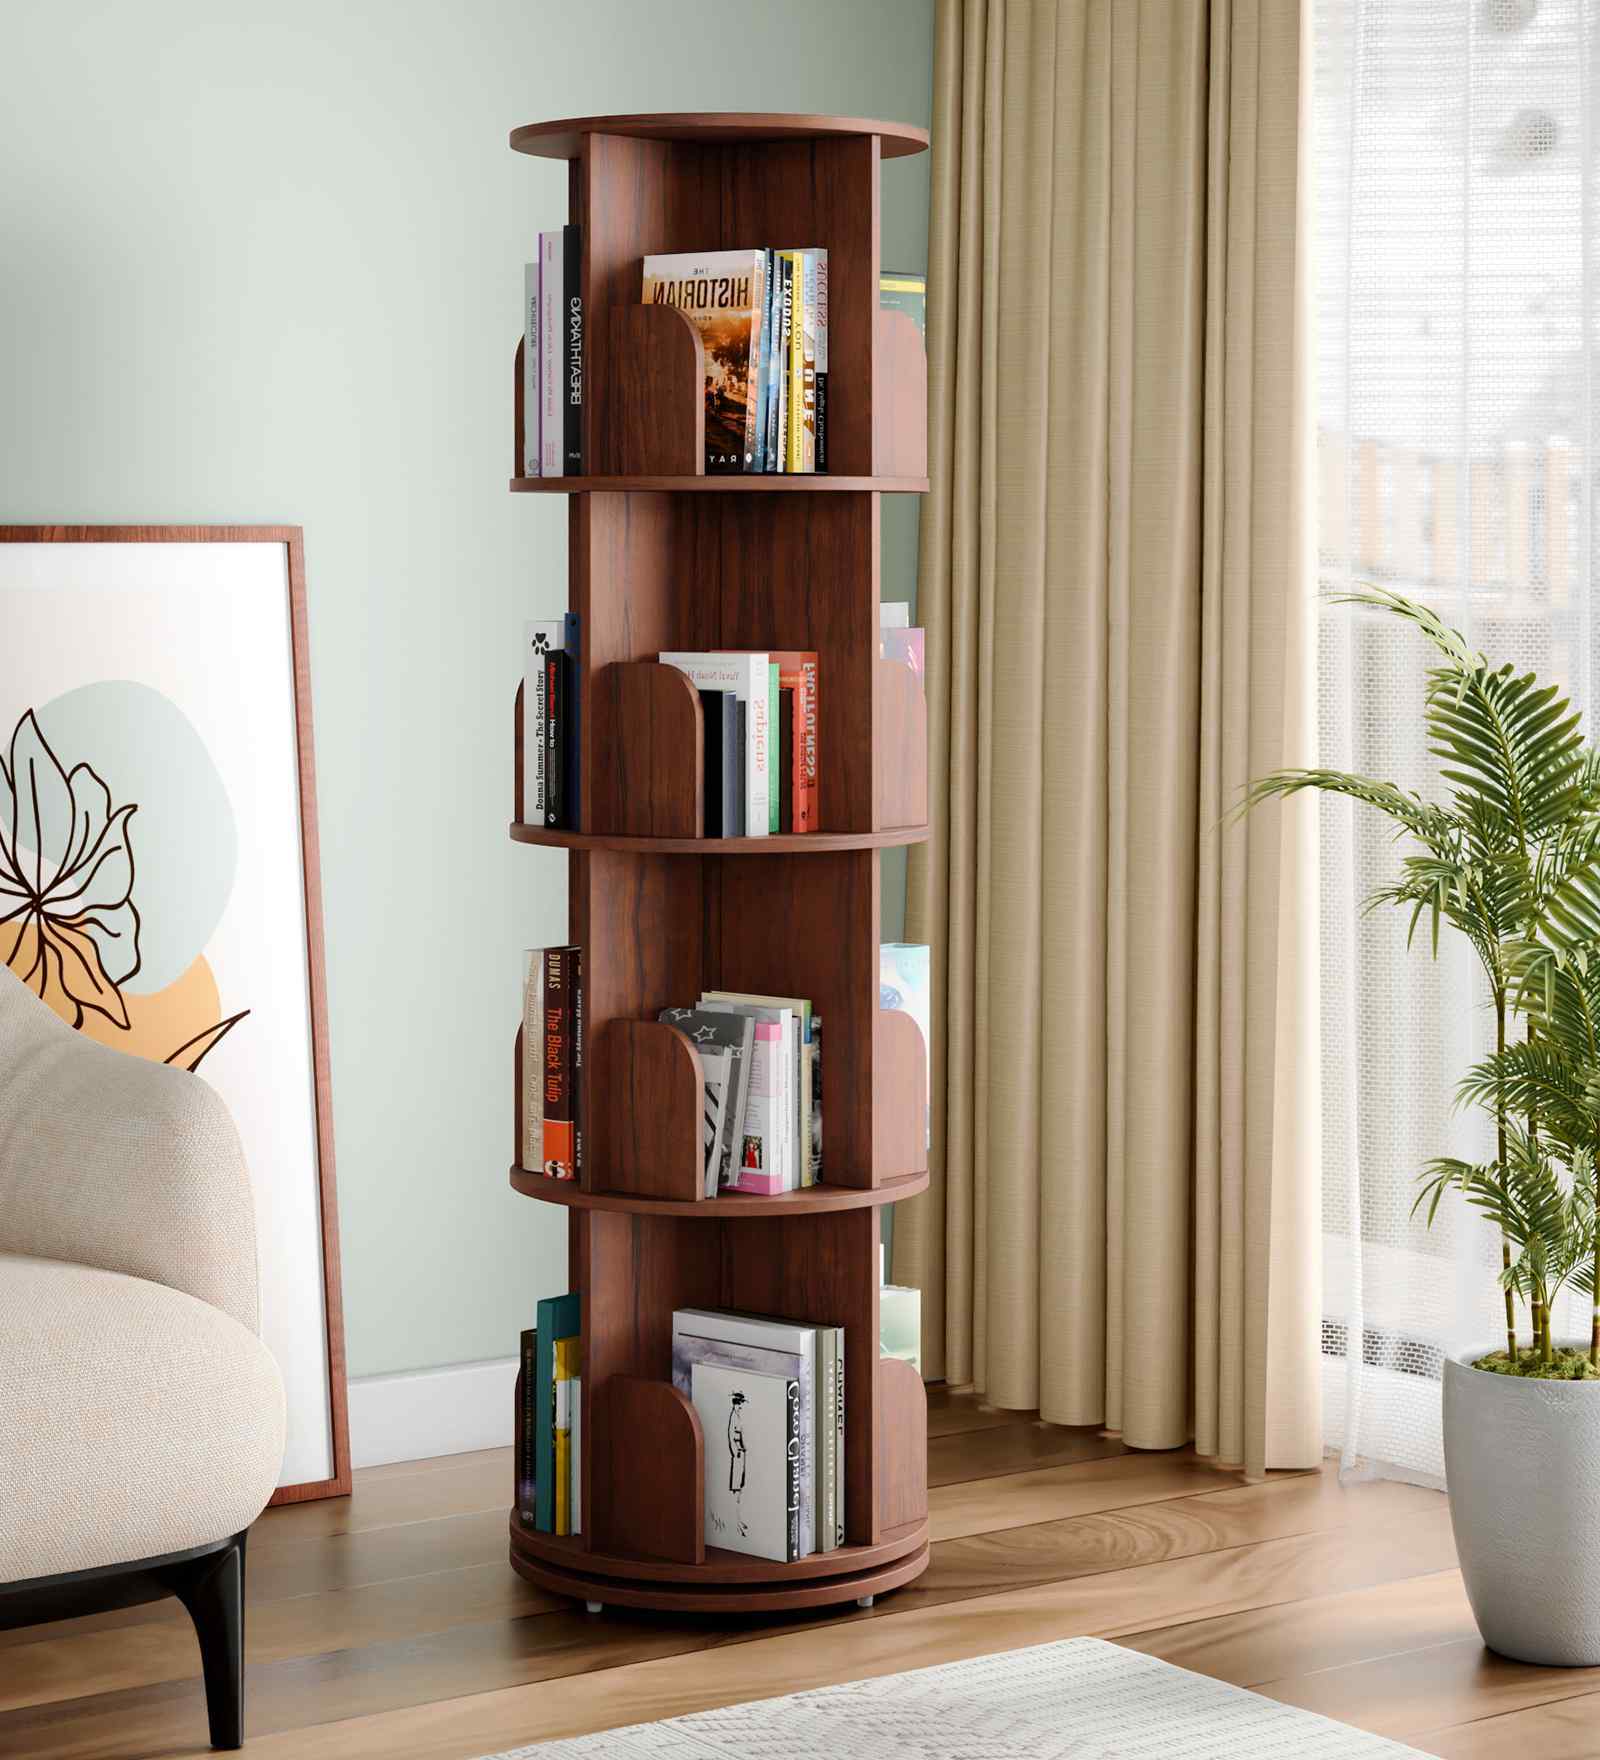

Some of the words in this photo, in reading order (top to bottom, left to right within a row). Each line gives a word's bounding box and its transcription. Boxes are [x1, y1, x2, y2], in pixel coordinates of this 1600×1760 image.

[536, 669, 545, 692] Story
[536, 693, 544, 720] Secret
[536, 721, 544, 737] The
[536, 745, 544, 780] Summer
[536, 782, 544, 810] Donna
[548, 953, 561, 990] DUMAS
[547, 1007, 562, 1031] The
[547, 1034, 562, 1069] Black
[546, 1073, 562, 1103] Tulip
